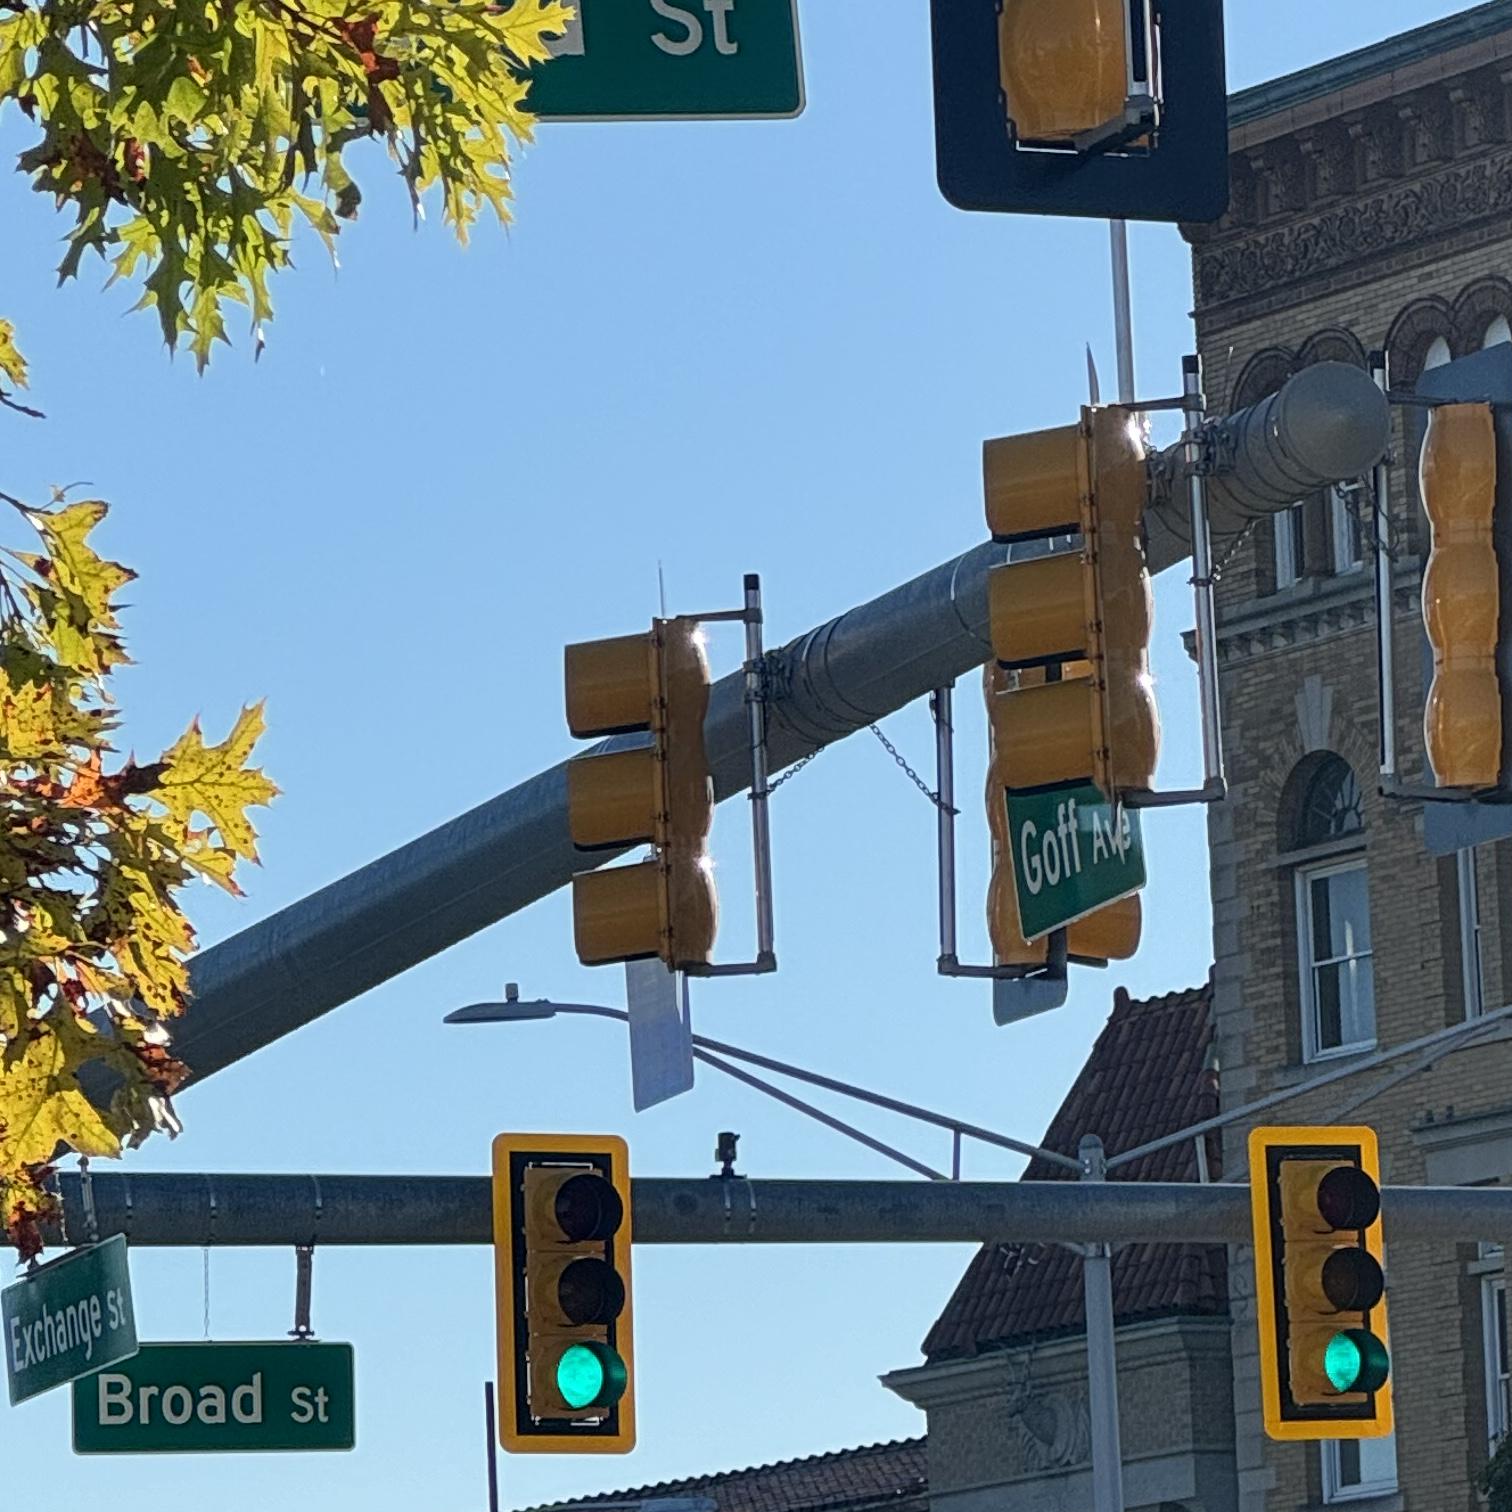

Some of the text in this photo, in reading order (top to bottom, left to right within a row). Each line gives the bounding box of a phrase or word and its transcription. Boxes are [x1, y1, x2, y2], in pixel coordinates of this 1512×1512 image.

[651, 0, 738, 55] St
[1021, 797, 1082, 895] Goff
[10, 1287, 126, 1373] Exchange St
[98, 1371, 329, 1425] Broad St
